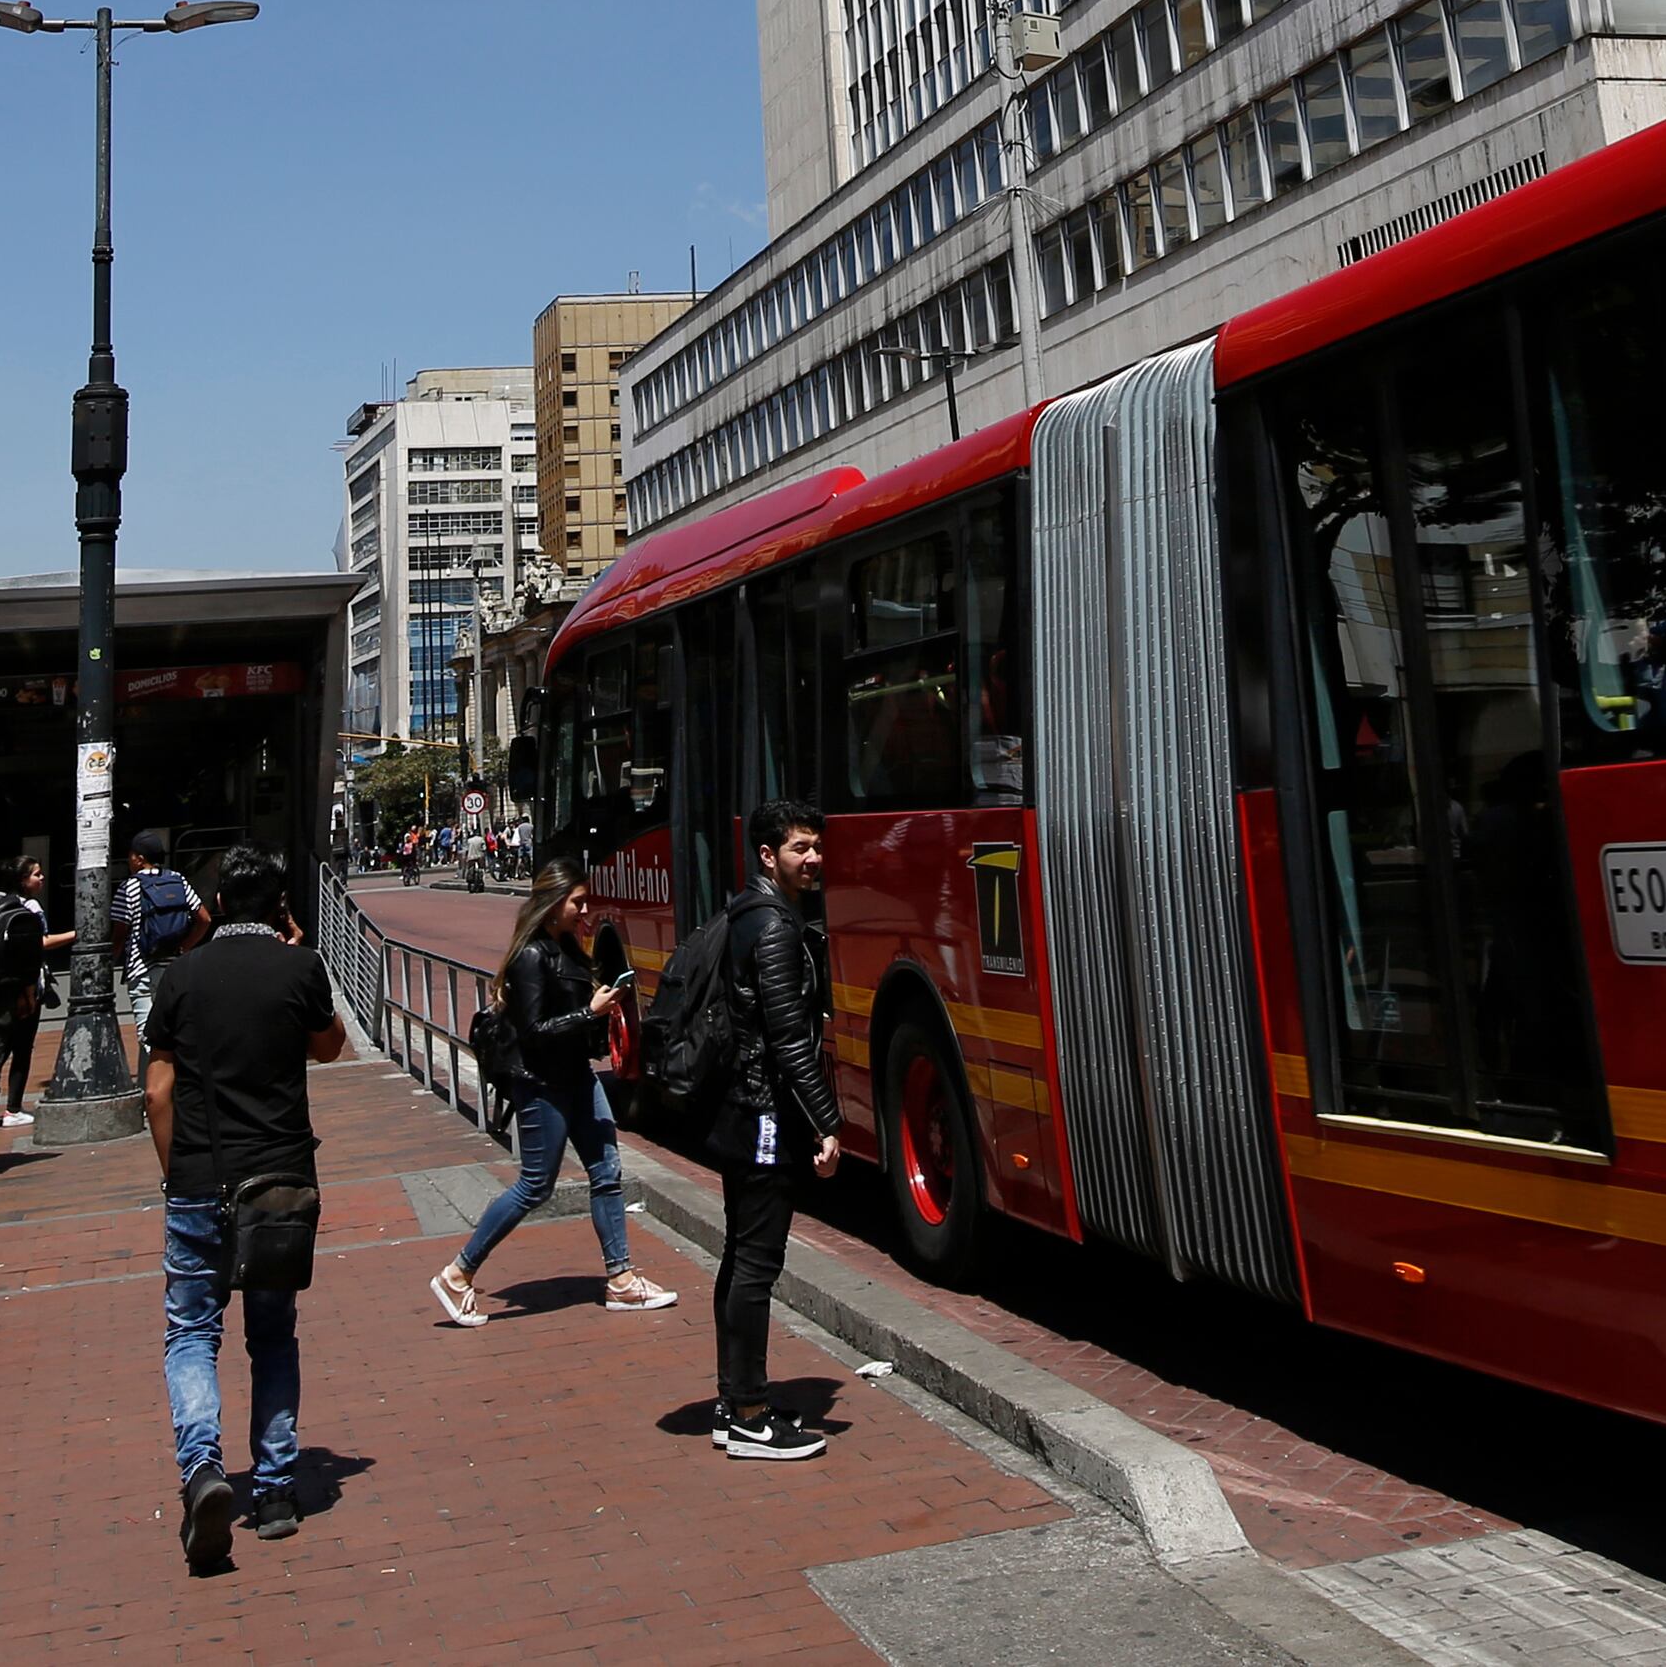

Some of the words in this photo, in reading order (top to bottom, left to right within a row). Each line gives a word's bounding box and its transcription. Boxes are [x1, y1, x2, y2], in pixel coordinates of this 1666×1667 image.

[247, 665, 273, 675] KFC
[128, 670, 178, 692] DOMICILIOS
[466, 796, 482, 809] 30
[583, 848, 669, 904] TransMilenio
